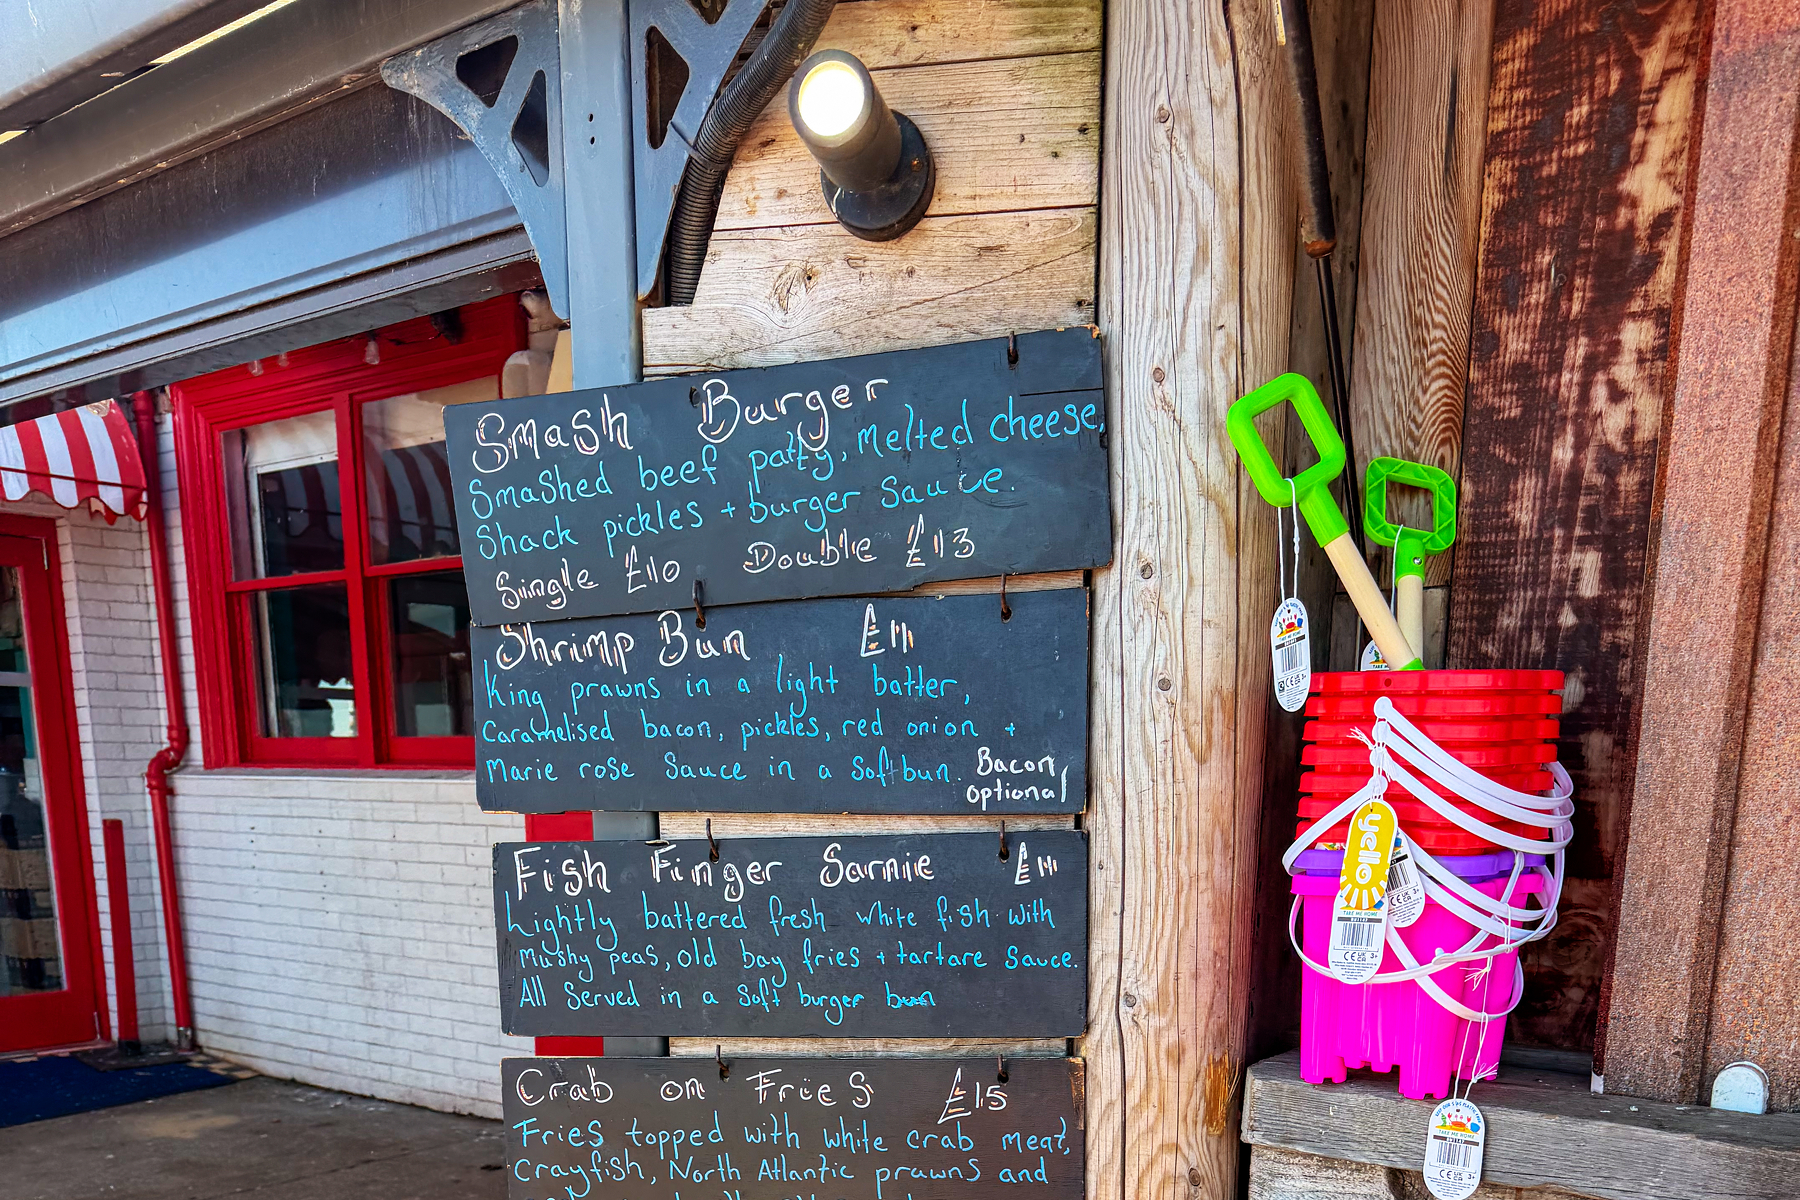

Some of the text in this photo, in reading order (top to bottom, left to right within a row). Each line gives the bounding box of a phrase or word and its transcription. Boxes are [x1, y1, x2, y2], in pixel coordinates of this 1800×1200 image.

[472, 378, 888, 473] Smash Burger
[469, 461, 612, 520] Smashed
[638, 444, 717, 491] beef
[748, 431, 847, 493] patty,
[989, 396, 1105, 442] cheese,
[476, 515, 579, 560] Shack
[603, 500, 703, 558] pickles
[720, 502, 736, 518] +
[748, 481, 860, 532] burger
[496, 513, 975, 609] Single £10 Double £13
[496, 622, 634, 674] Shrimp
[658, 610, 750, 668] Bun
[570, 676, 661, 715] prawns
[686, 673, 711, 697] in
[738, 678, 750, 694] a
[776, 654, 838, 718] light
[872, 662, 970, 704] batter,
[640, 709, 724, 741] bacon,
[741, 712, 831, 752] pickles,
[842, 708, 883, 737] red
[907, 716, 978, 737] onion
[1004, 722, 1016, 736] +
[486, 758, 558, 782] Marie
[579, 757, 634, 780] rose
[769, 756, 795, 781] in
[818, 764, 832, 779] a
[976, 747, 1056, 777] Bacon
[513, 847, 611, 900] Fish
[650, 844, 782, 902] Finger
[820, 843, 935, 887] Sarnie
[1356, 814, 1382, 885] yello
[505, 890, 1056, 956] Lightly battered fresh white fish with
[610, 944, 671, 974] peas,
[739, 939, 787, 988] bay
[803, 938, 860, 974] fries
[877, 951, 885, 965] +
[897, 941, 987, 968] tartare
[1344, 952, 1356, 961] CE
[520, 975, 546, 1008] All
[661, 983, 681, 1008] in
[703, 990, 718, 1004] a
[797, 982, 864, 1025] burger
[885, 981, 935, 1008] bun
[516, 1064, 613, 1106] Crab
[660, 1078, 705, 1101] on
[937, 1067, 1007, 1124] £15
[513, 1118, 604, 1147] Fries
[625, 1110, 724, 1159] topped
[744, 1112, 800, 1149] with
[824, 1116, 888, 1153] white
[669, 1153, 740, 1183] North
[758, 1154, 854, 1183] Atlantic
[875, 1159, 981, 1199] prawns
[998, 1156, 1048, 1184] and
[1440, 1170, 1452, 1179] CE
